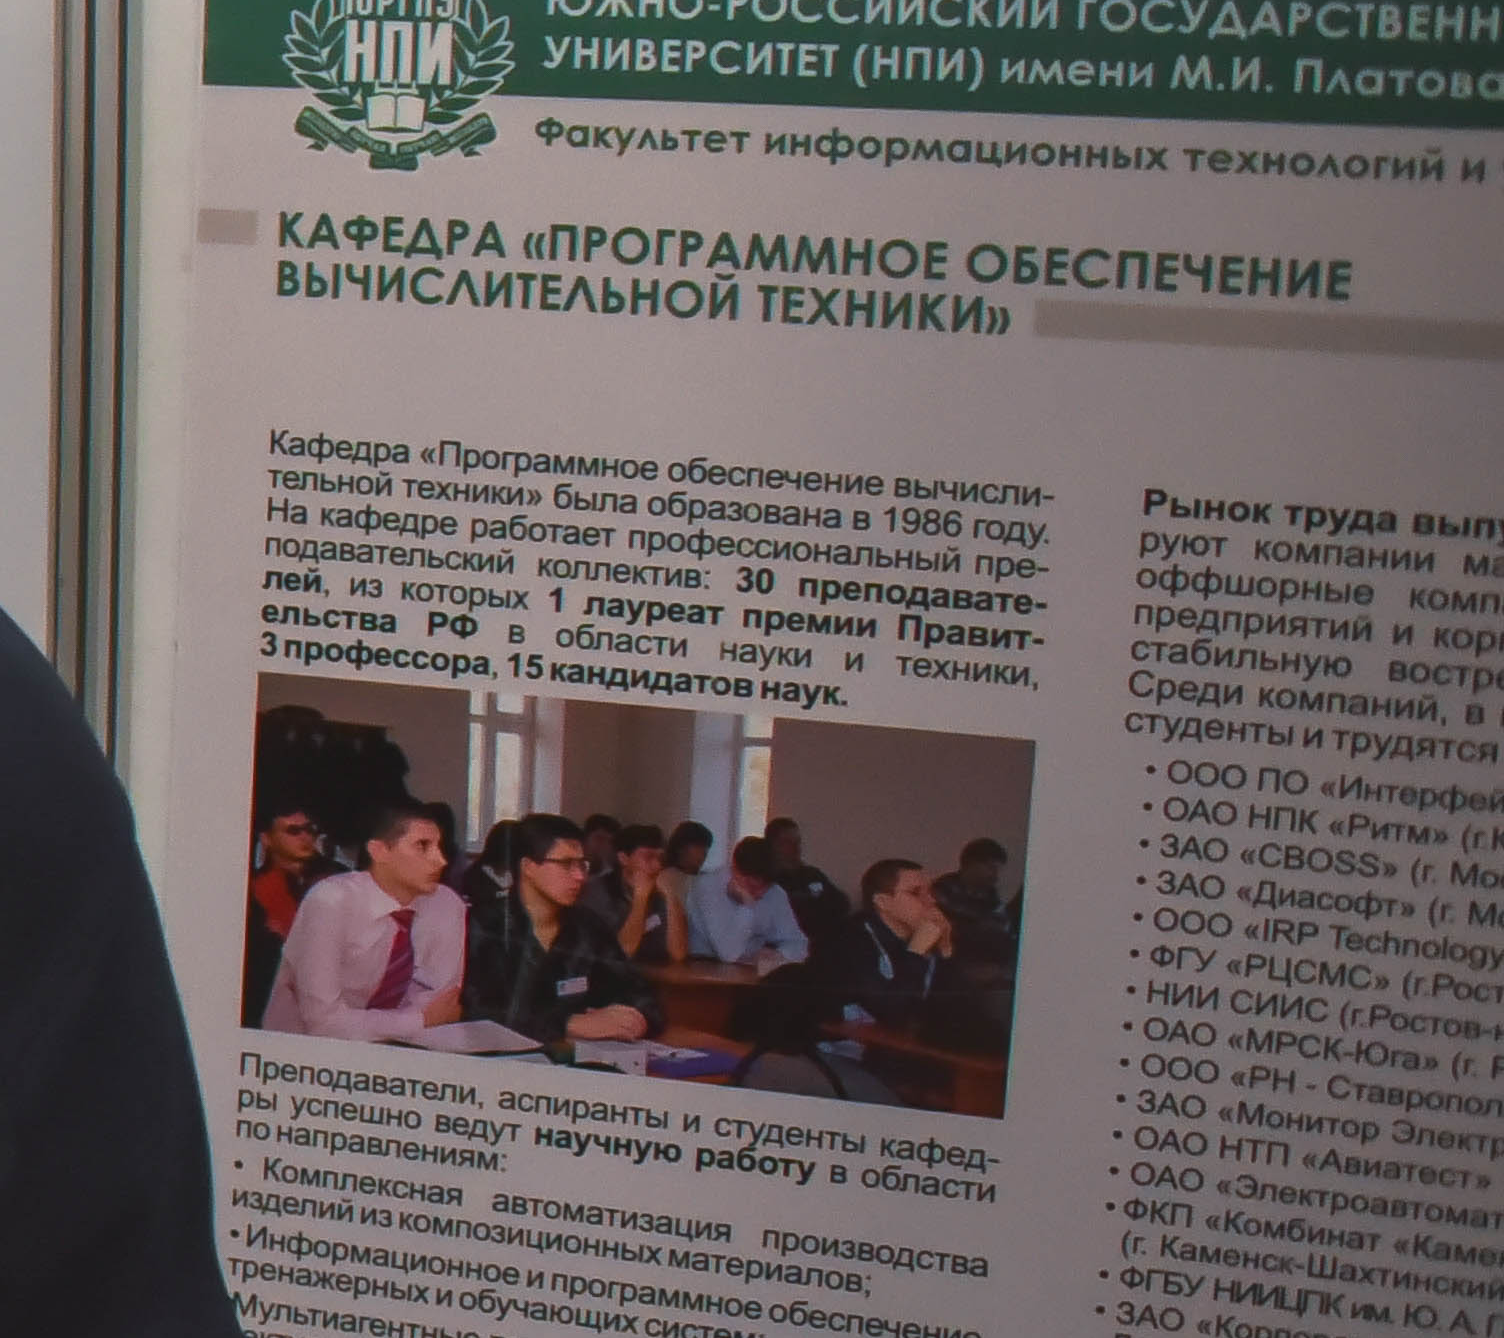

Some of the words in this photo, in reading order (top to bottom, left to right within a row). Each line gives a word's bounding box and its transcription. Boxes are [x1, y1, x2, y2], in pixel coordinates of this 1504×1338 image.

[344, 20, 454, 86] НПИ
[542, 36, 839, 77] УНИВЕРСИТЕТ
[853, 43, 983, 91] (НПИ)
[1001, 58, 1152, 87] имени
[1170, 55, 1272, 91] М.И.
[1294, 58, 1504, 99] Платова
[535, 117, 751, 157] Факультет
[764, 126, 1168, 170] информационных
[1182, 148, 1443, 180] технологий
[1461, 159, 1484, 183] и
[278, 211, 506, 260] КАФЕДРА
[523, 223, 947, 281] «ПРОГРАММНОЕ
[966, 243, 1351, 300] ОБЕСПЕЧЕНИЕ
[276, 260, 739, 320] ВЫЧИСЛИТЕЛЬНОЙ
[757, 284, 1010, 334] ТЕХНИКИ»
[269, 429, 410, 468] Кафедра
[420, 440, 658, 482] «Программное
[668, 457, 883, 496] обеспечение
[894, 477, 1054, 507] вычисли-
[267, 469, 392, 496] тельной
[401, 478, 542, 506] техники»
[553, 483, 637, 514] была
[647, 491, 842, 528] образована
[852, 510, 870, 530] в
[884, 506, 962, 537] 1986
[973, 519, 1048, 549] году.
[262, 567, 329, 597] лей,
[349, 577, 382, 598] из
[401, 581, 528, 612] которых
[549, 587, 562, 612] 1
[583, 596, 724, 626] лауреат
[743, 608, 876, 637] премии
[898, 613, 1044, 650] Правит-
[1153, 907, 1233, 938] ООО
[1243, 917, 1319, 945] «IRP
[240, 1051, 483, 1109] Преподаватели,
[498, 1091, 668, 1129] аспиранты
[682, 1113, 700, 1133] и
[714, 1117, 865, 1153] студенты
[880, 1137, 999, 1173] кафед-
